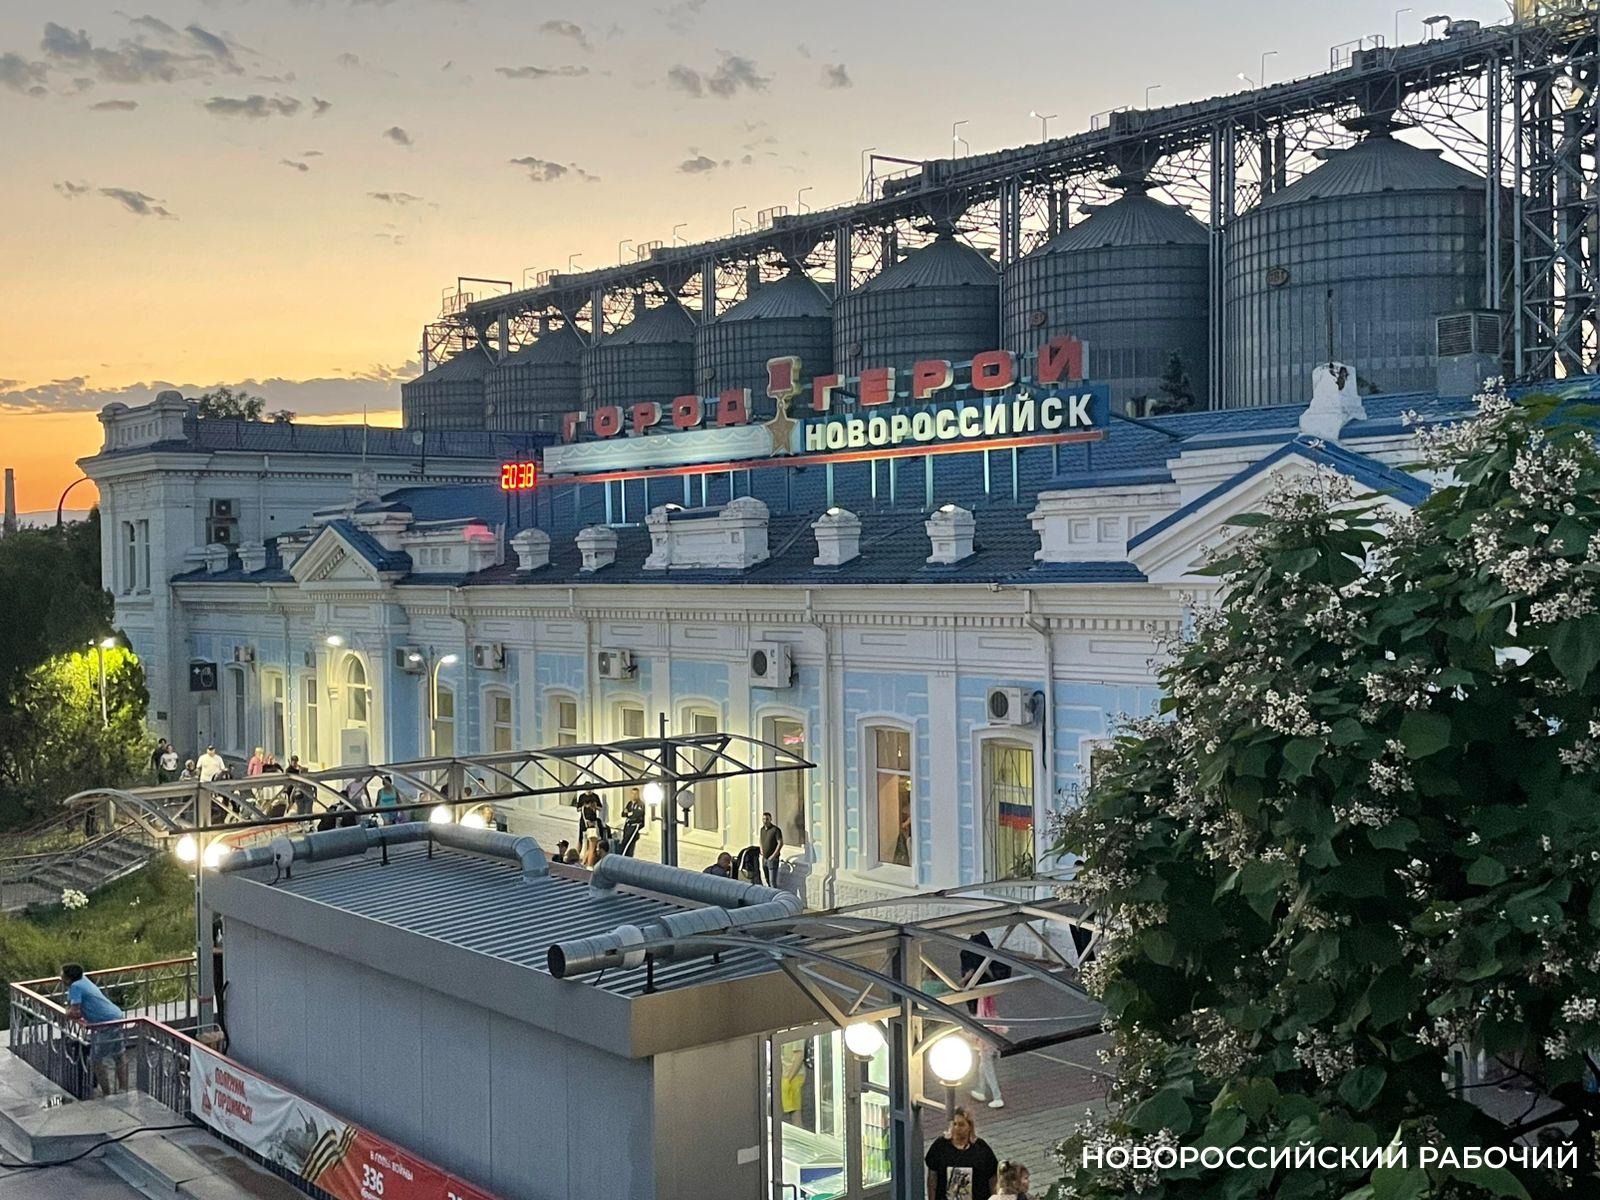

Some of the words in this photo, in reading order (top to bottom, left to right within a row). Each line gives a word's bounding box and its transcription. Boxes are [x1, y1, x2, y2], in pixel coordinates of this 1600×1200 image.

[563, 387, 752, 442] ГОРОД
[812, 332, 1090, 411] ГЕРОЙ
[805, 392, 1093, 452] НОВОРОССИЙСК
[362, 1163, 384, 1195] 336
